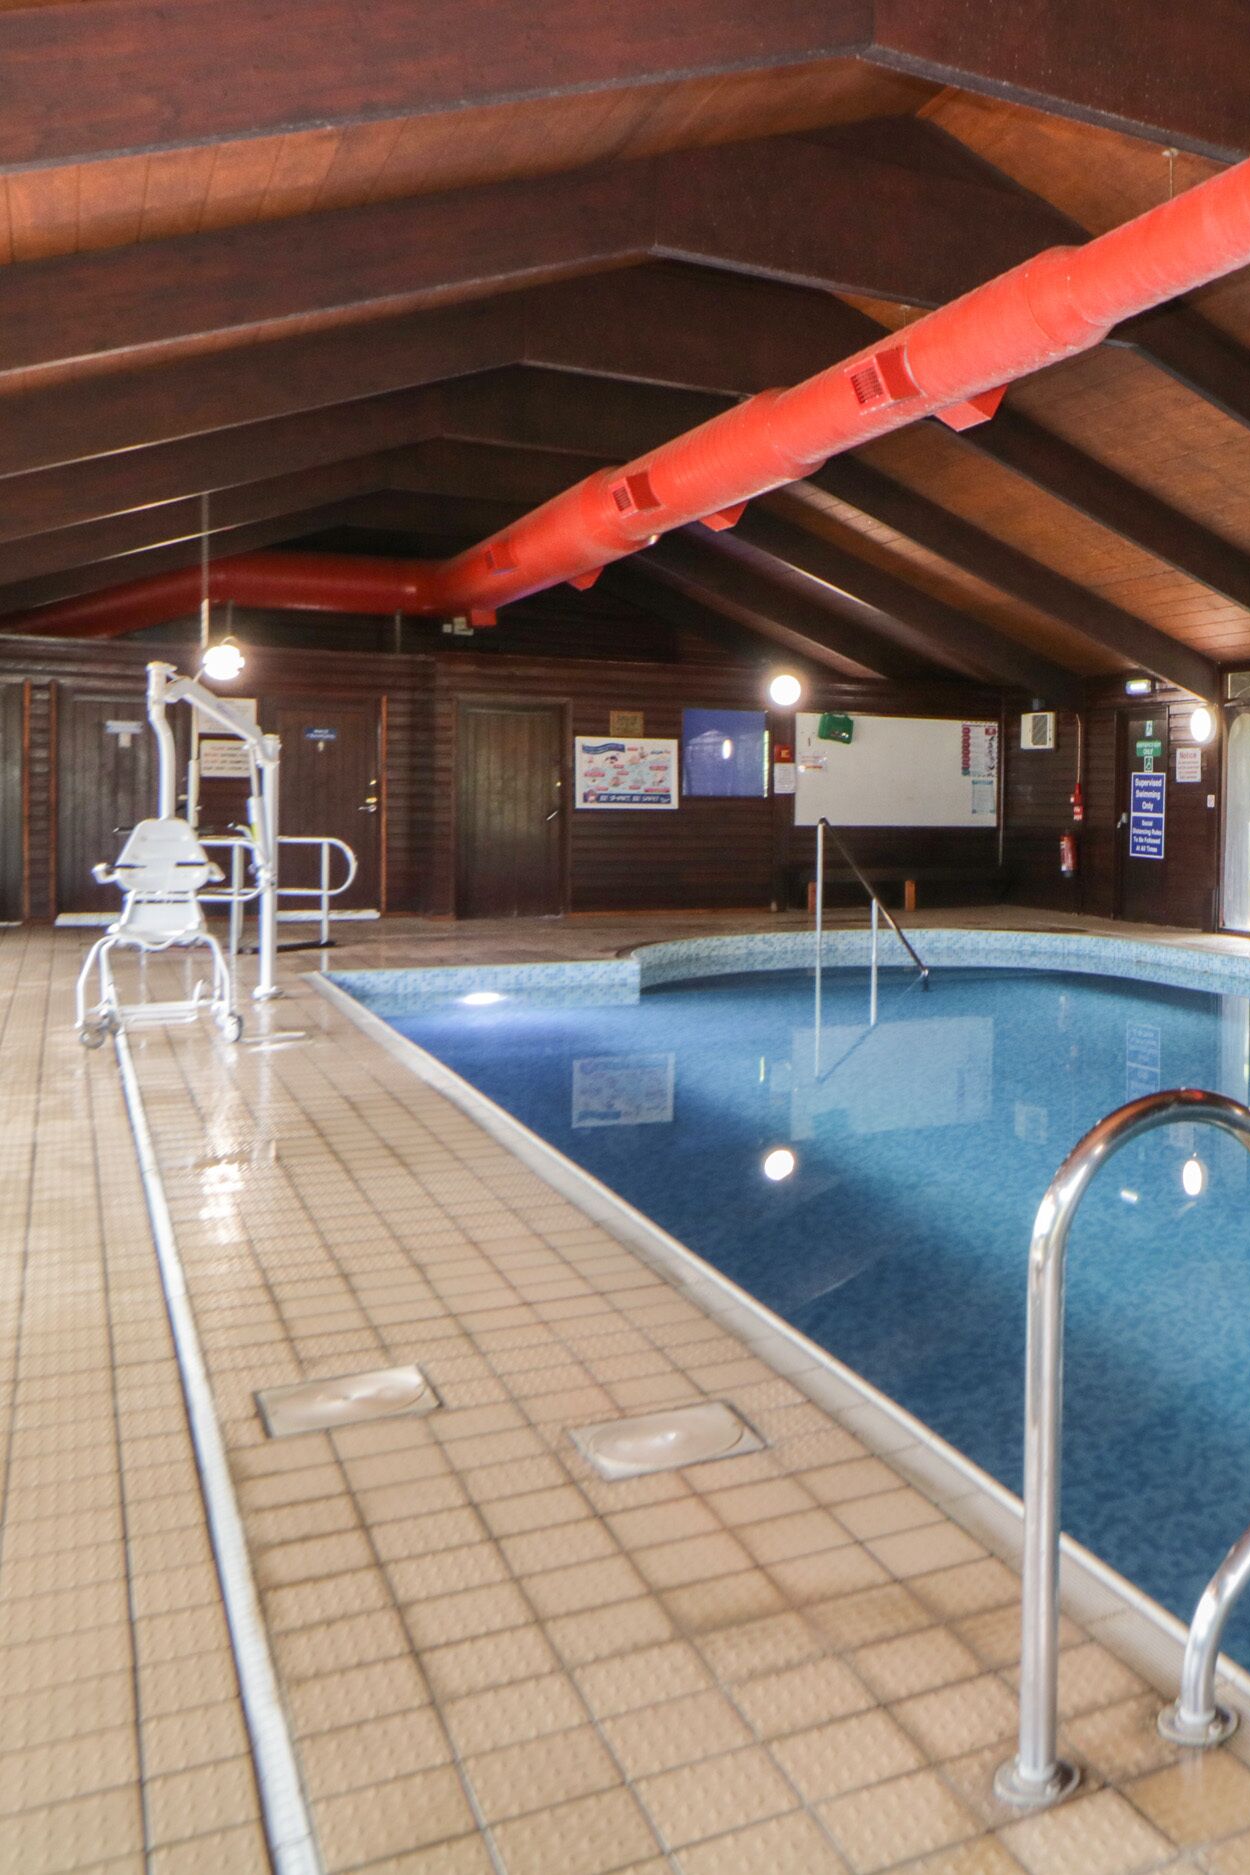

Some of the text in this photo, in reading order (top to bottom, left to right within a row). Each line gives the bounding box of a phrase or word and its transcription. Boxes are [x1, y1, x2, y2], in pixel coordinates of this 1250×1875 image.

[1135, 778, 1162, 789] Supervised
[1135, 790, 1161, 800] Swimming
[1142, 801, 1154, 811] Only
